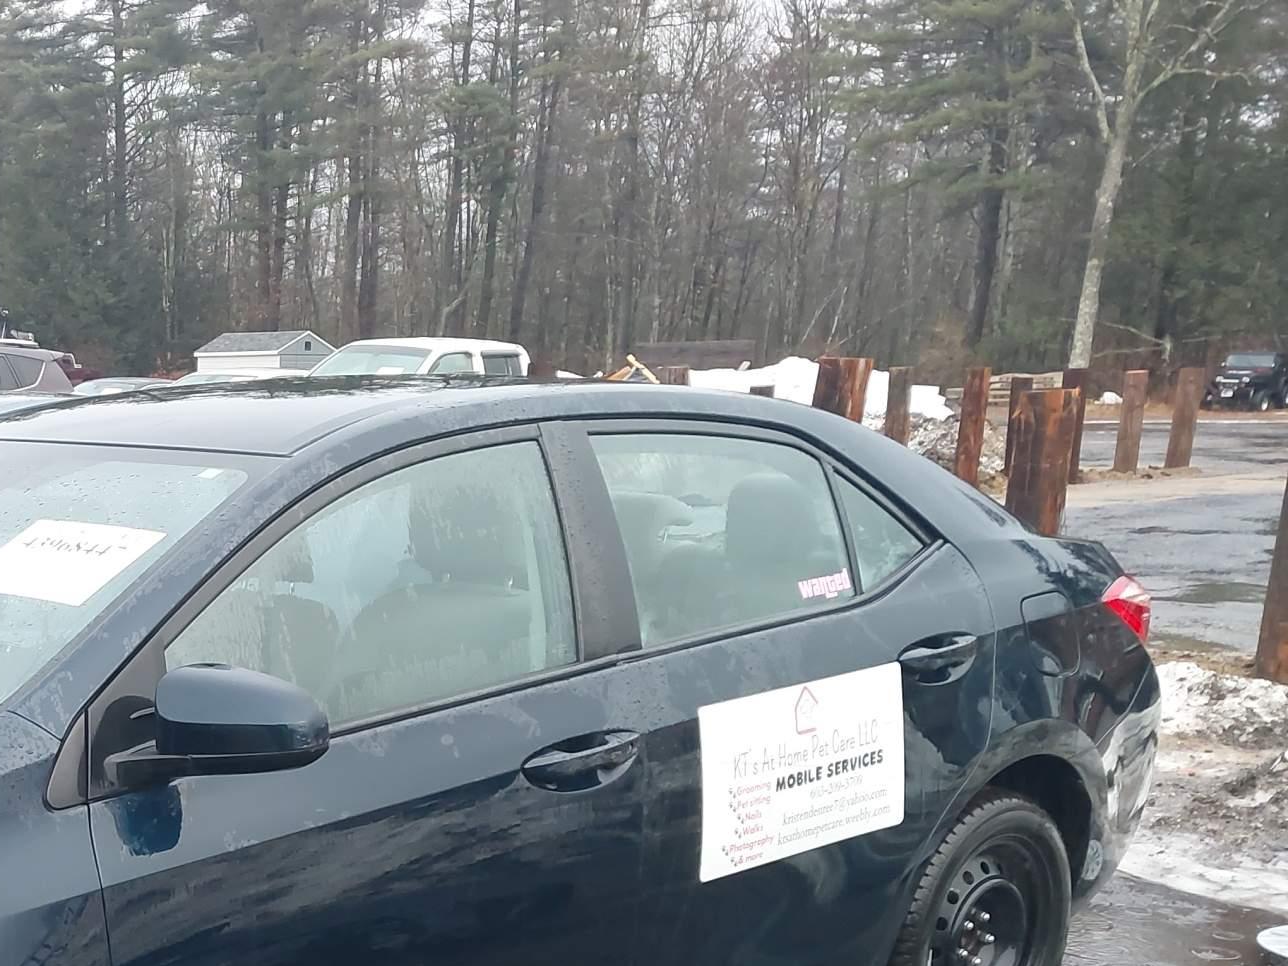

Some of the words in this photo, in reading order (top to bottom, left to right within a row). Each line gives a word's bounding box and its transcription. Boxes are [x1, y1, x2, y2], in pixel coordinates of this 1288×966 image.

[762, 748, 775, 771] At
[778, 744, 808, 768] Home
[811, 735, 829, 760] Pet
[832, 729, 856, 754] Care
[858, 719, 879, 747] LLC
[775, 765, 823, 792] MOBILE
[827, 749, 884, 778] SERVICES
[728, 834, 774, 855] Photography
